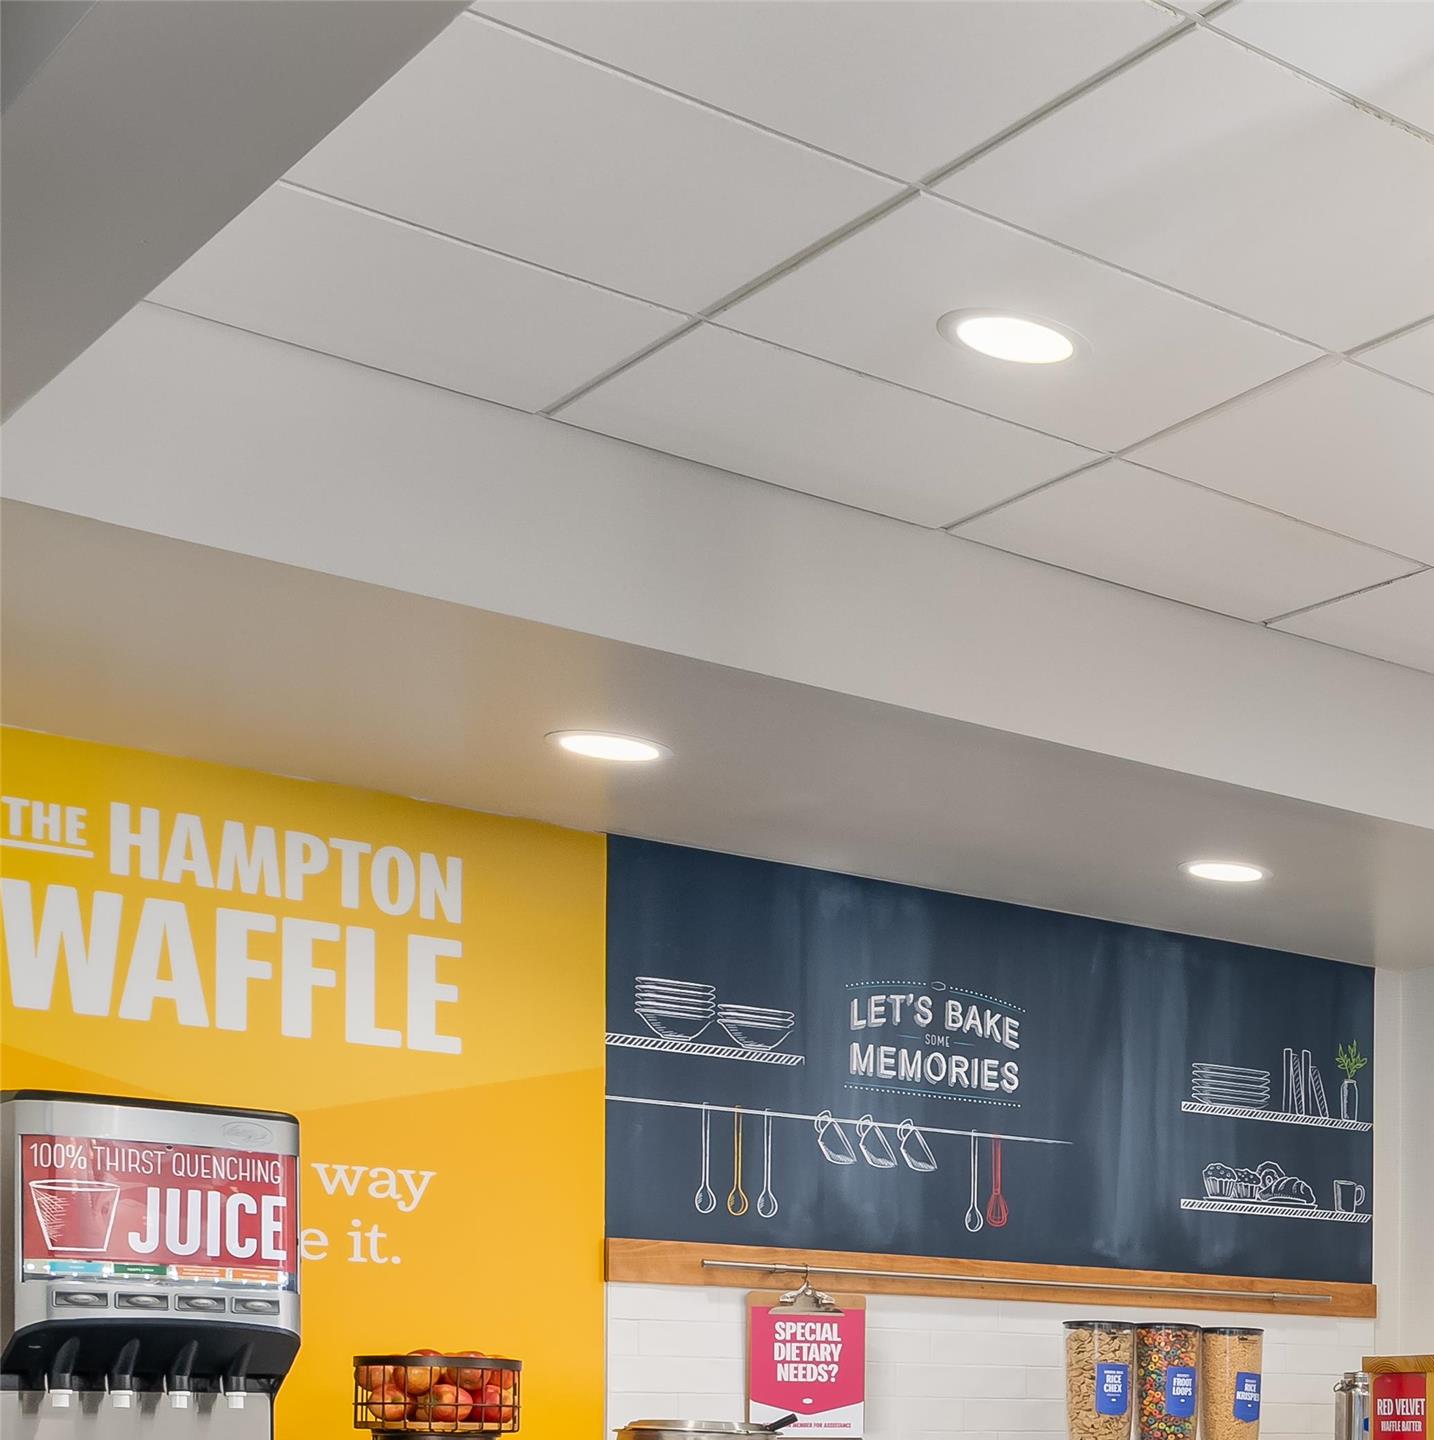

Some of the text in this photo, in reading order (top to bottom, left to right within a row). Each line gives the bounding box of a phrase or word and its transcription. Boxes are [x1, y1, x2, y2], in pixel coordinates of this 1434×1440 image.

[2, 796, 463, 925] THE HAMPTON
[0, 876, 463, 1055] WAFFLE
[850, 993, 1021, 1051] LET'S BAKE
[924, 1033, 951, 1048] SOME
[849, 1042, 1020, 1094] MEMORIES
[29, 1142, 281, 1185] 100% THIRST QUENCHING
[310, 1161, 438, 1213] way
[127, 1186, 288, 1261] JUICE
[346, 1218, 402, 1265] it.
[774, 1321, 842, 1342] SPECIAL
[773, 1342, 843, 1362] DIETARY
[776, 1363, 839, 1383] NEEDS?
[1103, 1384, 1122, 1393] CHEX
[1106, 1374, 1122, 1383] RICE
[1377, 1398, 1426, 1416] RED VELVET
[1380, 1420, 1423, 1432] WAFFLE BATTER
